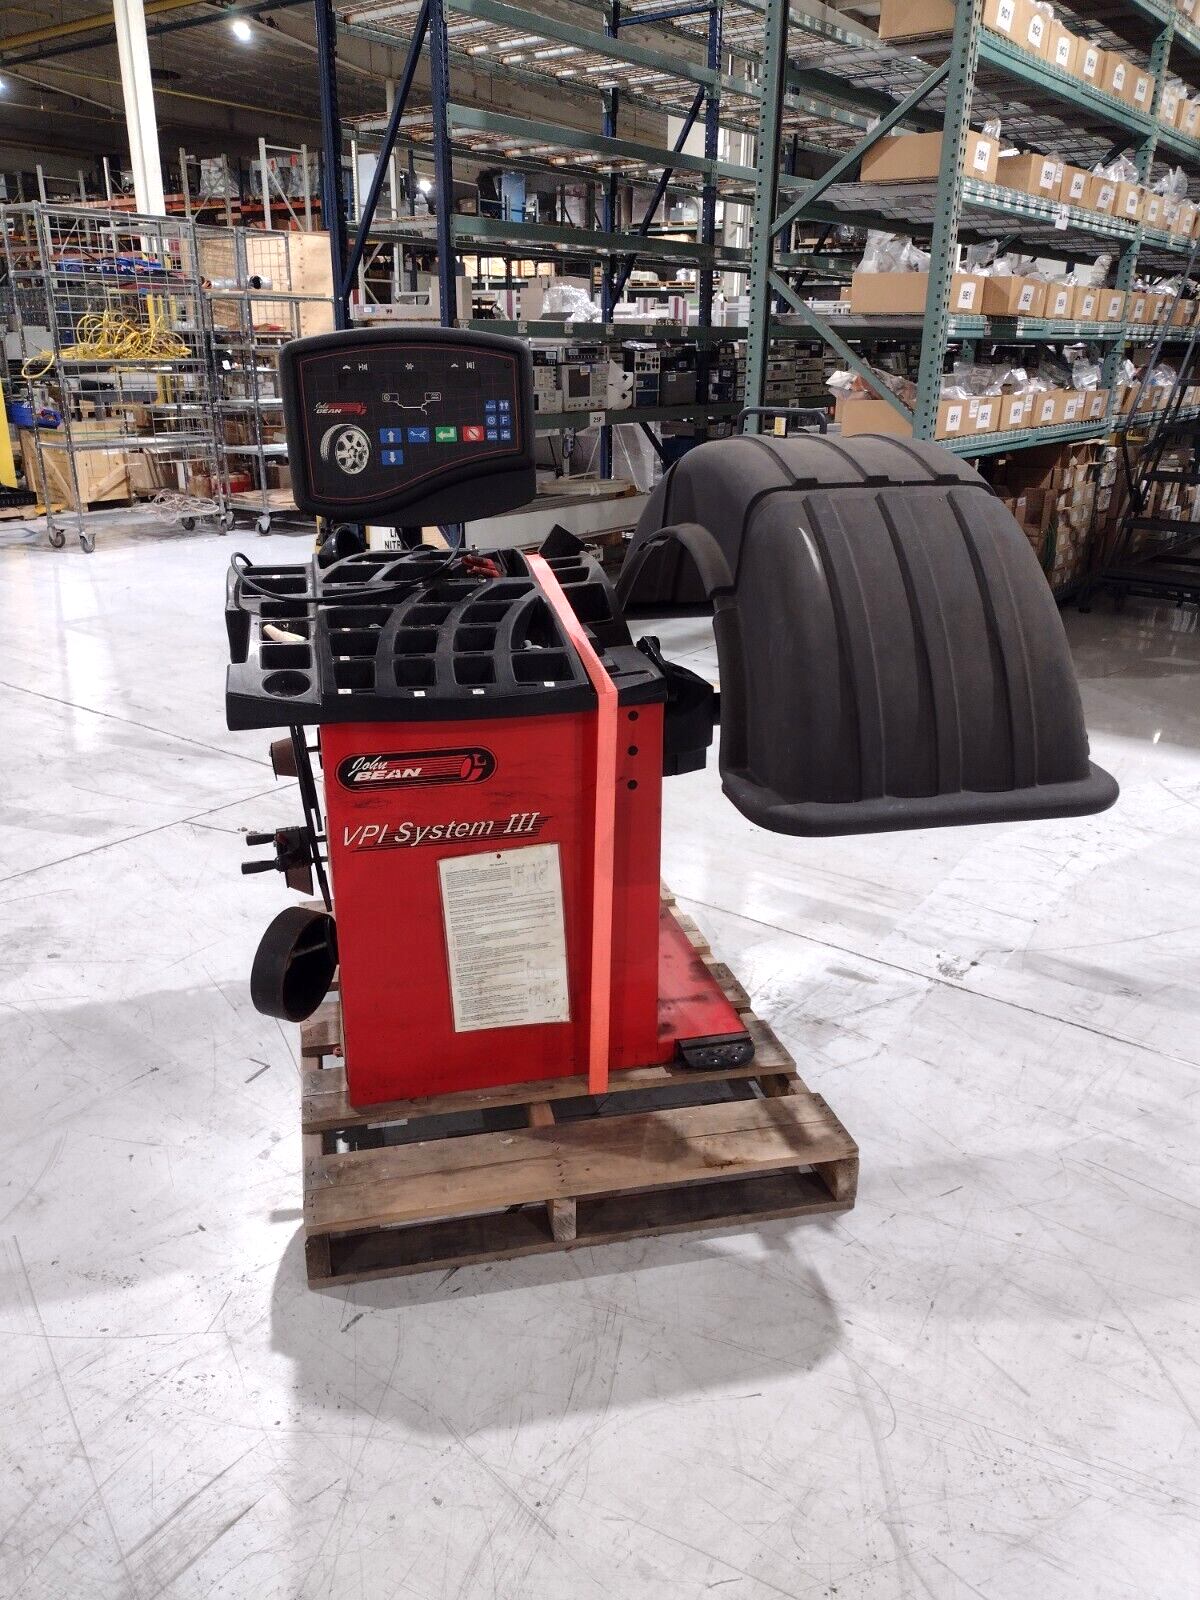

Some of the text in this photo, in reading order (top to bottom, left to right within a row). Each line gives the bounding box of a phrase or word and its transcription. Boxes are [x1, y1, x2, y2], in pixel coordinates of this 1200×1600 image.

[348, 755, 388, 777] John
[353, 768, 422, 782] BEAN
[343, 812, 540, 847] VPI System III
